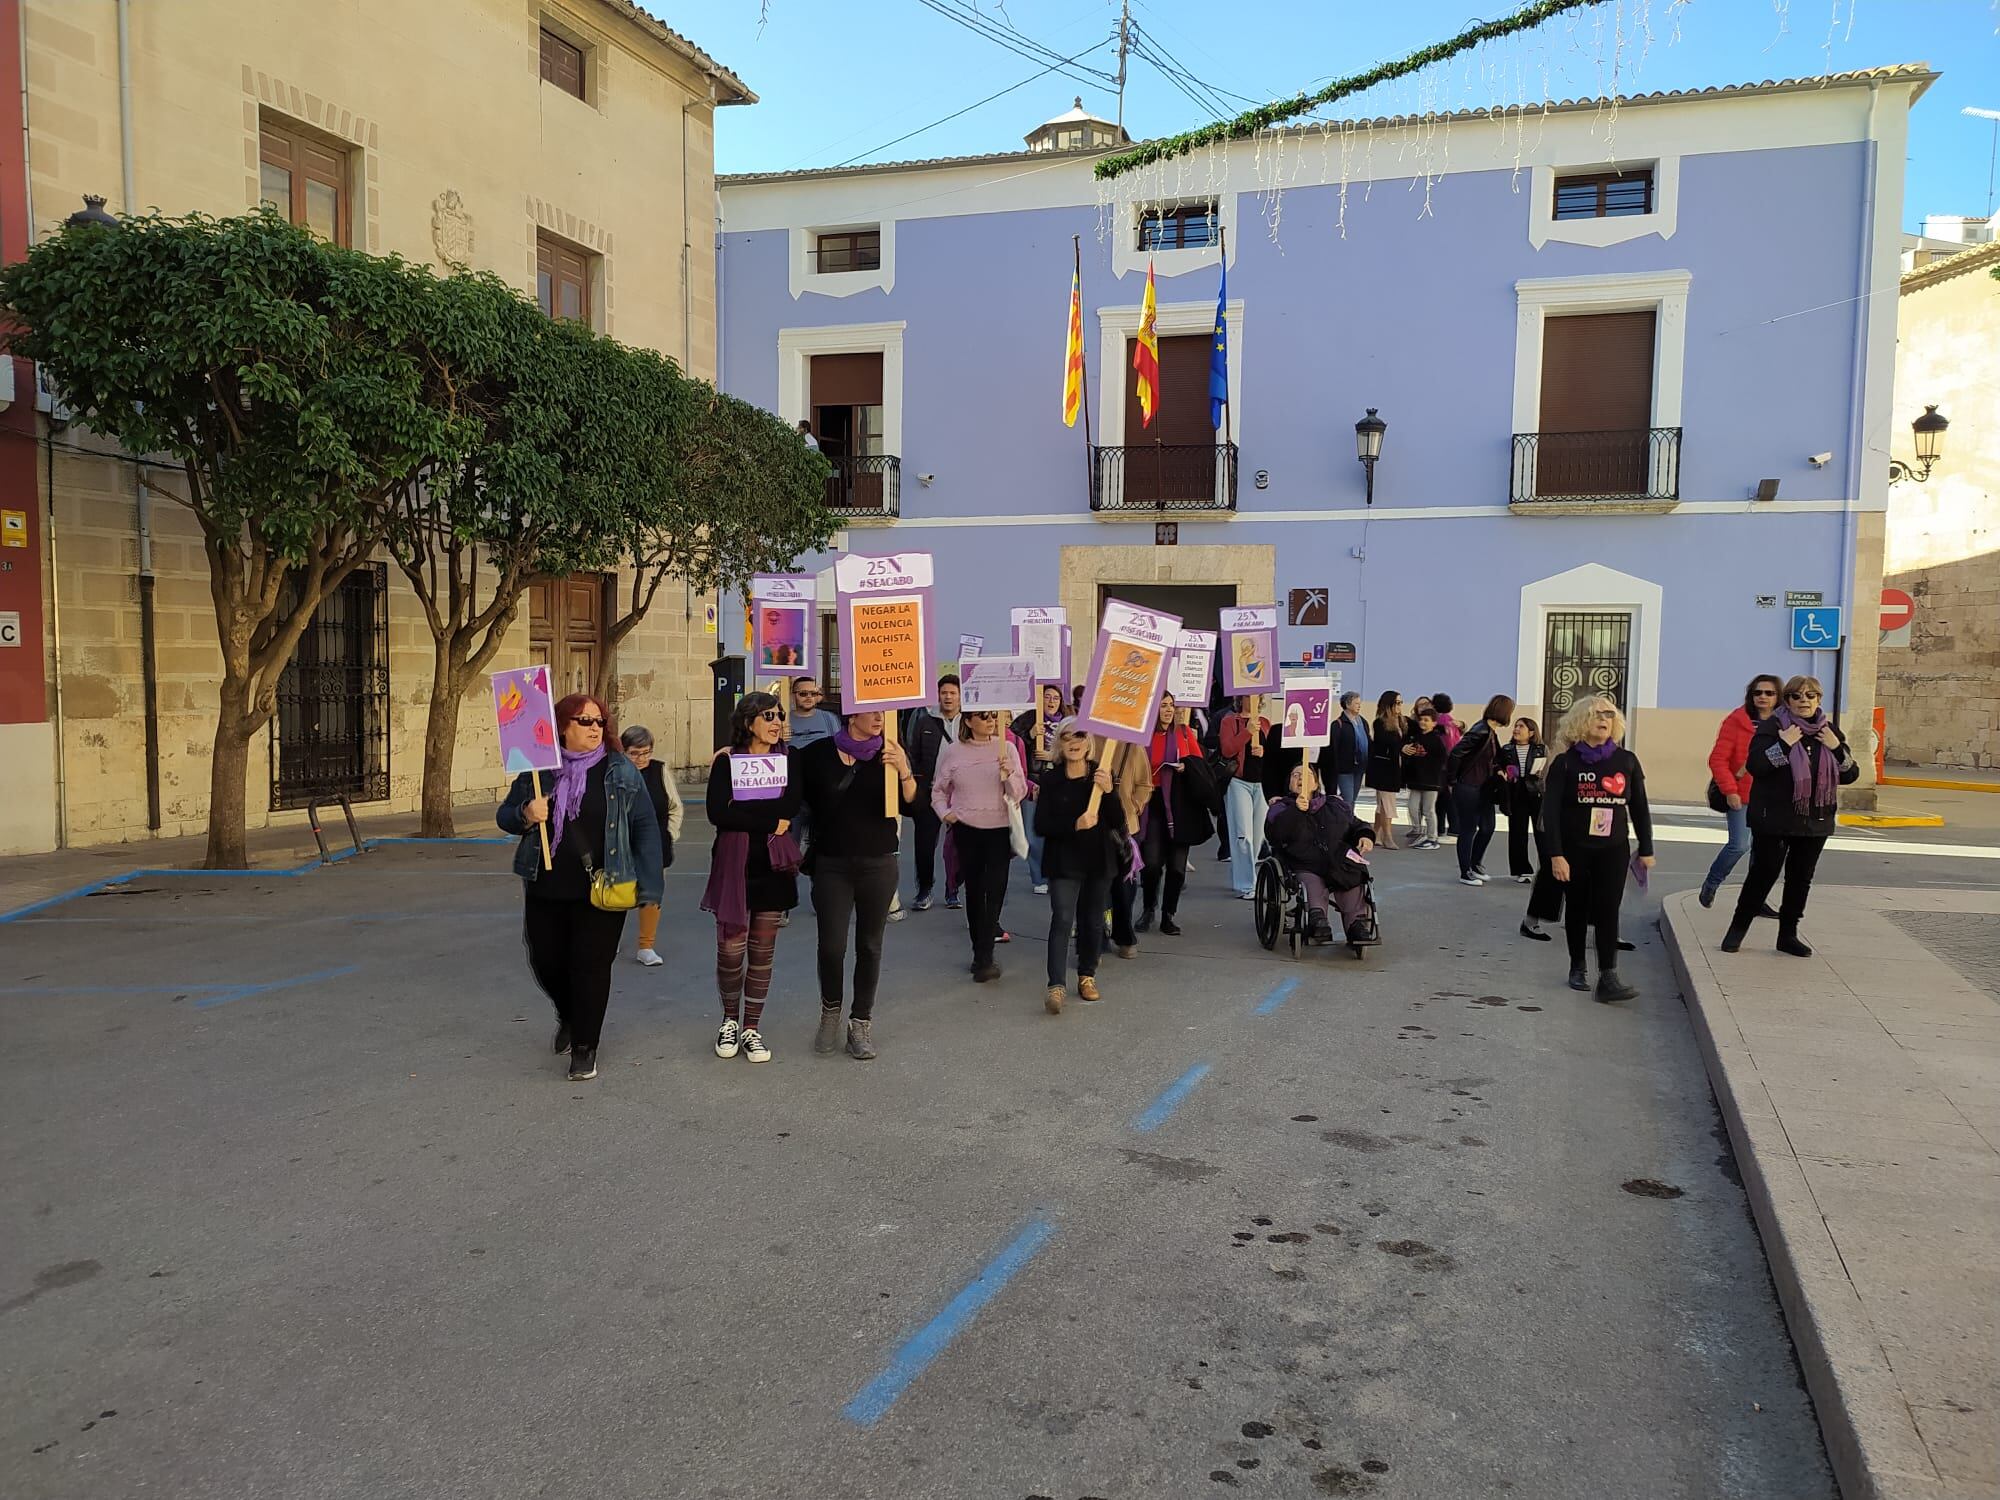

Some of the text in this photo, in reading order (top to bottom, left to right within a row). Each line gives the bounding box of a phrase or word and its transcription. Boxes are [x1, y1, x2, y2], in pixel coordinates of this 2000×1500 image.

[866, 558, 902, 575] 25N
[859, 576, 914, 588] #SEACABO
[862, 605, 911, 616] NEGAR LA
[860, 619, 913, 630] VIOLENCIA
[882, 648, 894, 657] ES
[862, 661, 914, 673] VIOLENCIA
[718, 678, 728, 691] P
[864, 676, 914, 687] MACHISTA
[740, 758, 776, 775] 25N
[733, 775, 787, 787] #SEACABO
[1578, 772, 1596, 782] no
